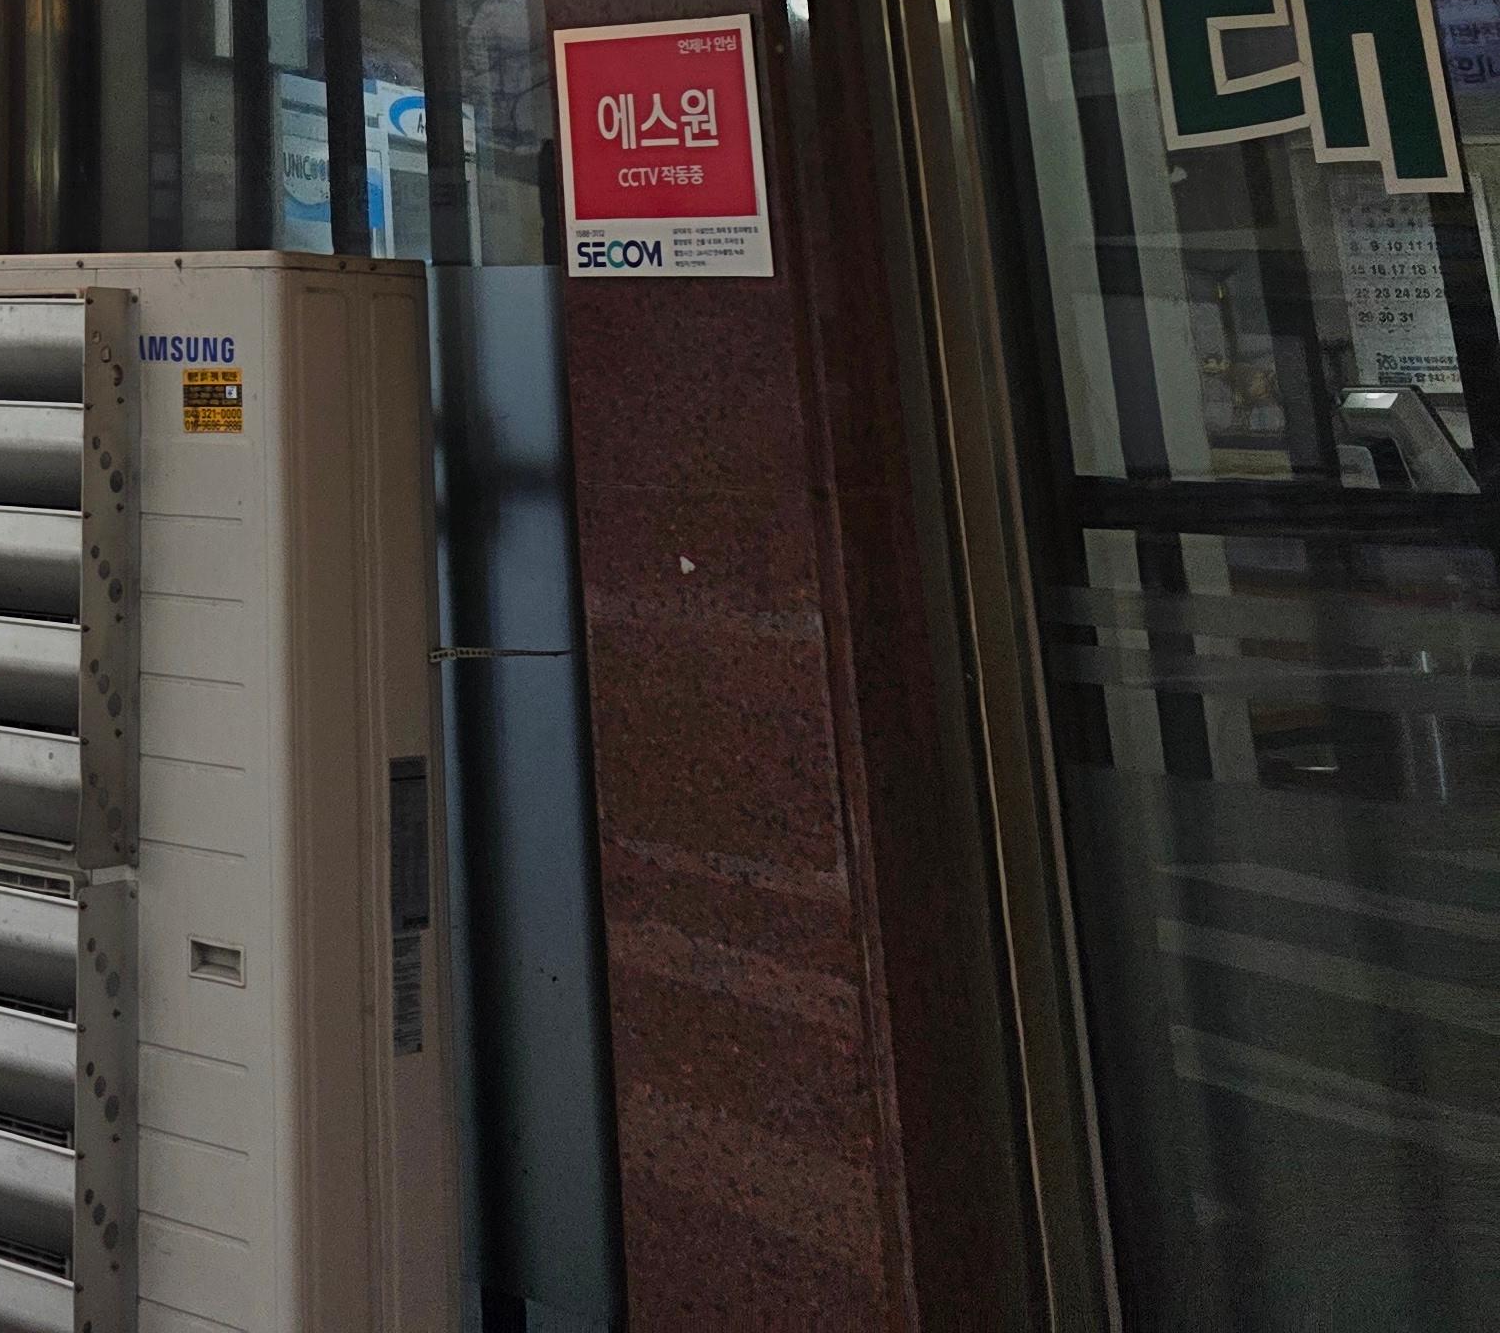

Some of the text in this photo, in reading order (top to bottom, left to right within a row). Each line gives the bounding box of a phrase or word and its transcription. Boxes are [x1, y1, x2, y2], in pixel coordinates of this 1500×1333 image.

[597, 88, 719, 150] 에스원
[618, 164, 704, 188] CCTV 작동중
[577, 240, 663, 269] SECOM
[138, 336, 235, 363] MSUNG
